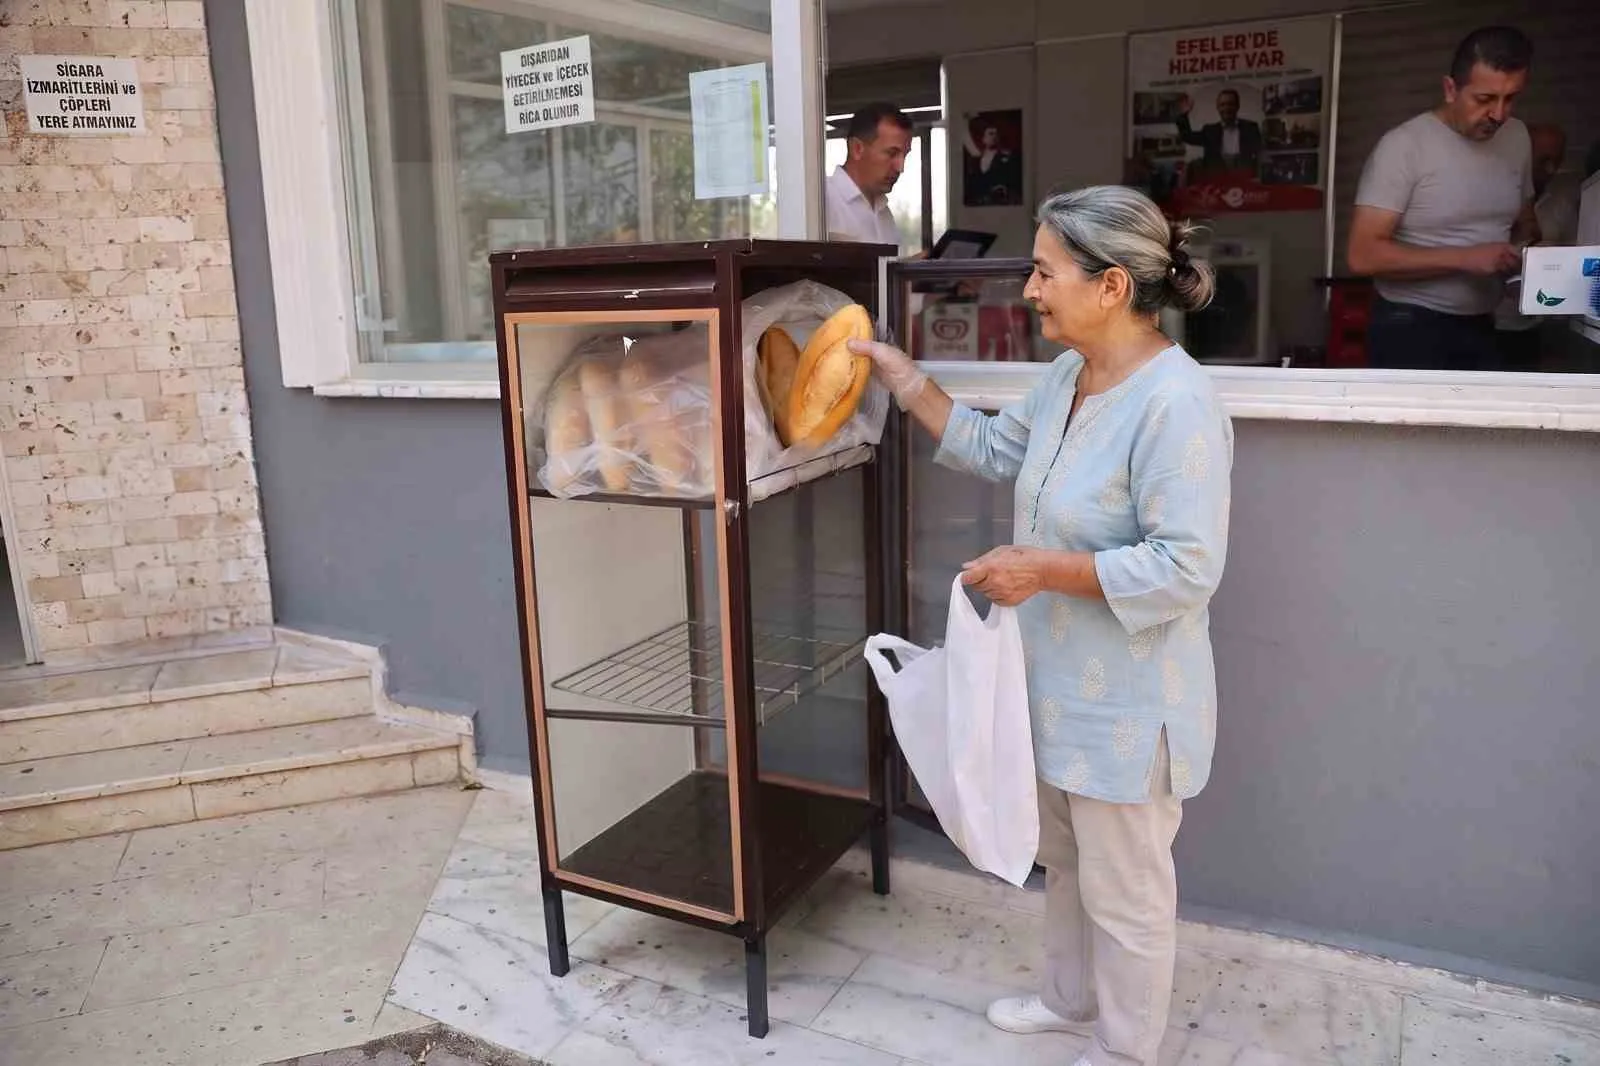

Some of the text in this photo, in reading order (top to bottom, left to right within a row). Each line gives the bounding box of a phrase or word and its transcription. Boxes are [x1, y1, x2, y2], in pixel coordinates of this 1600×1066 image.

[1176, 30, 1279, 55] EFELER'DE
[520, 46, 570, 68] DIŞARIDAN
[1244, 51, 1285, 68] VAR
[56, 61, 104, 77] SİGARA
[505, 62, 589, 88] YİYECEK ve İÇECEK
[27, 78, 136, 95] İZMARİTLERİNİ ve
[513, 81, 583, 106] GETİRİLMEMESİ
[59, 96, 111, 113] ÇÖPLERİ
[37, 115, 137, 129] YERE ATMAYINIZ
[519, 104, 580, 125] RİCA OLUNUR
